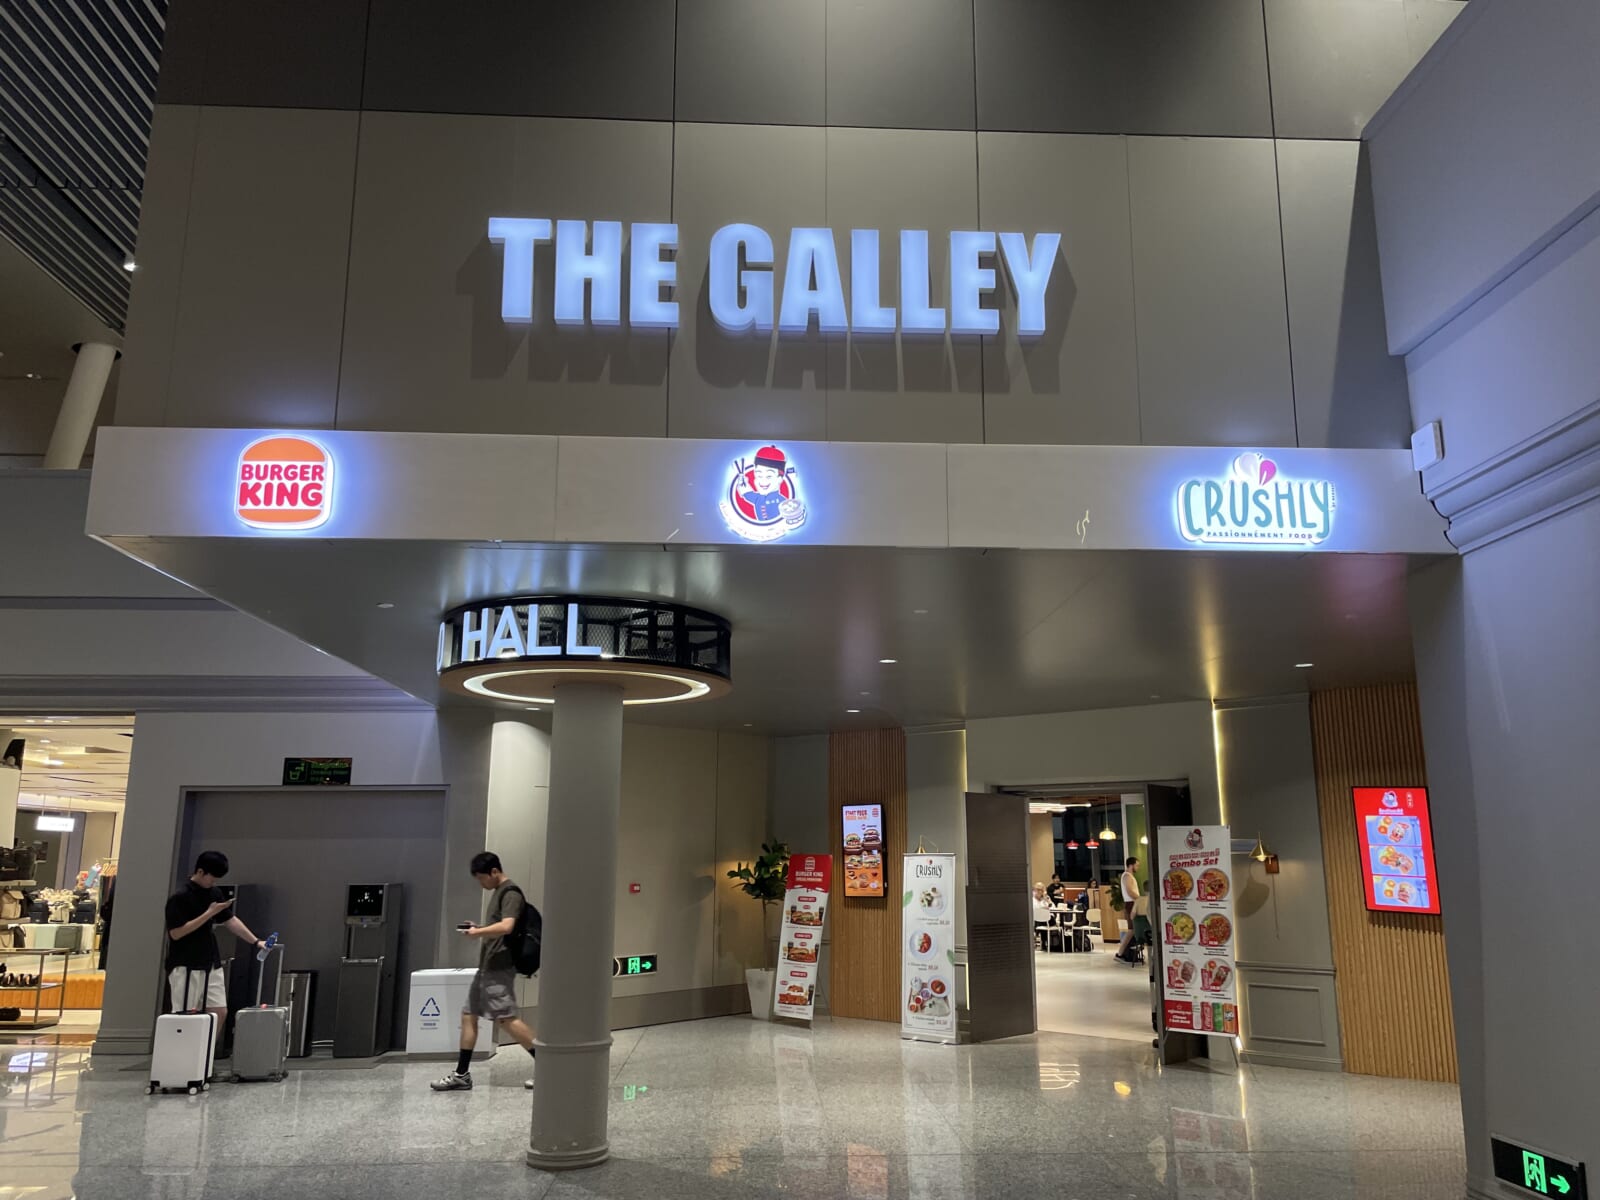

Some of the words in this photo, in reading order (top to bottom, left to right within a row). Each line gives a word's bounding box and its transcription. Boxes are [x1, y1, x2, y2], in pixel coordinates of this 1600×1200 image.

[488, 216, 679, 328] THE
[708, 222, 1062, 336] GALLEY
[241, 464, 325, 482] BURGER
[239, 482, 323, 507] KING
[1184, 479, 1330, 540] CRUSHLY
[1288, 532, 1313, 540] FOOD
[461, 602, 602, 662] HALL
[1169, 859, 1201, 868] Combo
[1203, 857, 1218, 866] Set
